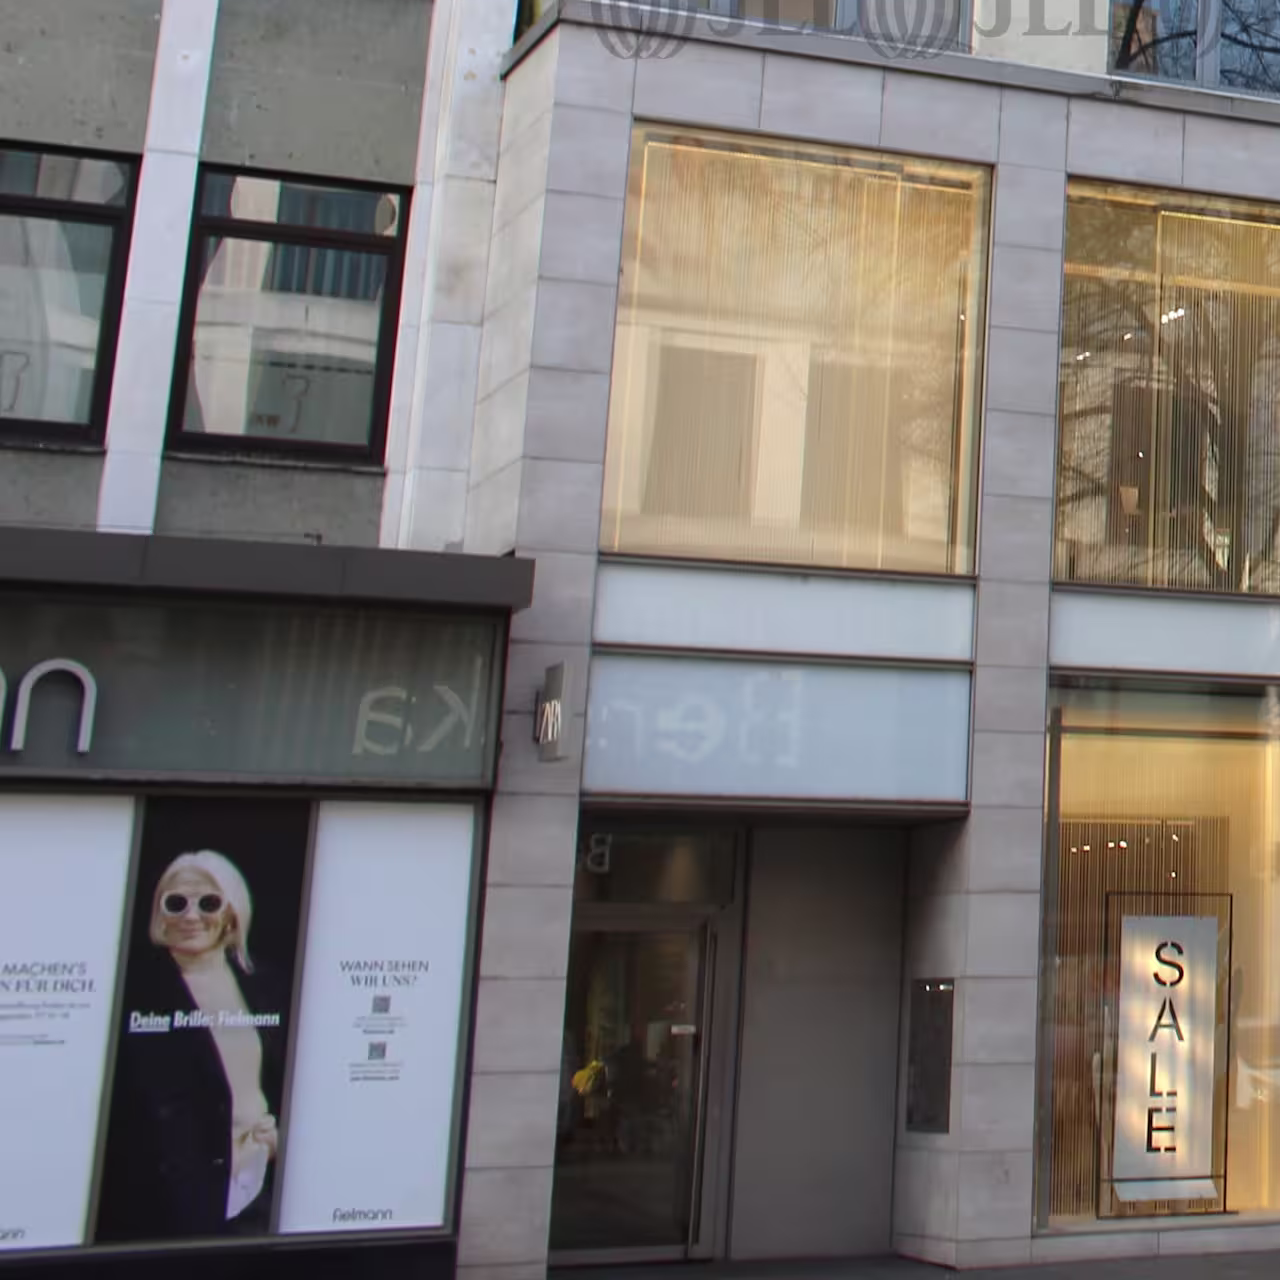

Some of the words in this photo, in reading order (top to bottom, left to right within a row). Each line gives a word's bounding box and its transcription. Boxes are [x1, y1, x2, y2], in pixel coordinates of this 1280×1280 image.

[340, 960, 385, 973] WANN
[387, 961, 429, 973] SEHEN
[130, 1011, 171, 1028] Deine
[218, 1010, 280, 1027] Fielmann
[1146, 941, 1184, 1153] SALE
